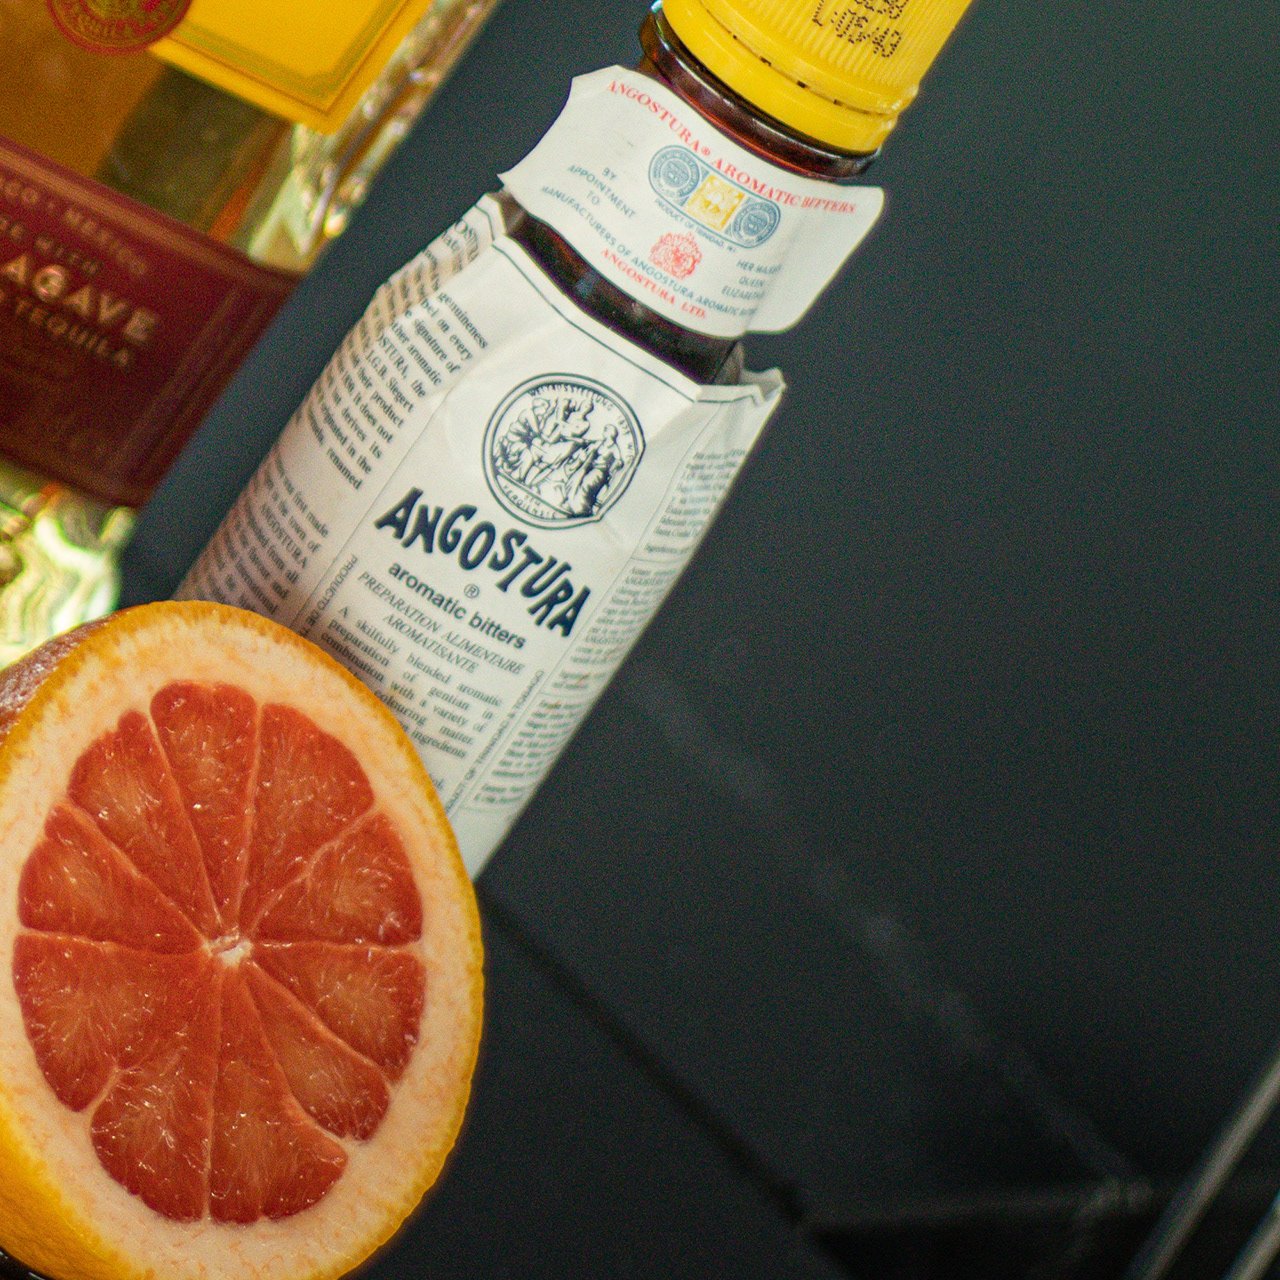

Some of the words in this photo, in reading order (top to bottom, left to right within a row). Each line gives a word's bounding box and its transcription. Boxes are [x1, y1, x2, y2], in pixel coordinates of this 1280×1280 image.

[568, 164, 637, 220] APPOINTMENT
[587, 191, 601, 206] TO
[602, 167, 618, 181] BY
[710, 157, 802, 208] AROMATIC
[801, 196, 857, 214] BITTERS
[541, 186, 616, 248] MANUFACTURERS
[617, 243, 632, 258] OF
[631, 256, 694, 300] ANGOSTURA
[736, 259, 756, 272] HER
[0, 255, 157, 345] AGAVE
[600, 247, 676, 306] ANGOSTURA
[413, 318, 448, 362] signature
[445, 361, 461, 374] of
[437, 318, 450, 334] on
[448, 334, 473, 362] every
[438, 292, 489, 350] genuineness
[407, 343, 442, 387] aromatic
[410, 378, 427, 398] the
[370, 390, 405, 429] product
[386, 376, 415, 413] Siegert
[341, 406, 367, 442] derives
[369, 441, 383, 459] its
[359, 402, 379, 428] does
[376, 424, 394, 444] not
[326, 447, 363, 491] renamed
[346, 442, 357, 458] in
[356, 454, 372, 475] the
[306, 511, 329, 538] made
[307, 540, 322, 554] of
[285, 569, 300, 585] all
[317, 553, 358, 612] PRODUCTO
[373, 486, 591, 638] ANGOSTURA
[357, 571, 441, 634] PREPARATION
[441, 630, 525, 674] ALIMENTAIRE
[388, 562, 468, 620] aromatic
[468, 611, 527, 650] bitters
[328, 619, 390, 667] preparation
[402, 671, 419, 683] of
[427, 686, 471, 711] gentian
[338, 605, 349, 619] A
[354, 620, 400, 655] skilfully
[406, 652, 452, 684] blended
[457, 683, 503, 708] aromatic
[382, 613, 480, 674] AROMATISANTE
[321, 632, 385, 683] combination
[390, 680, 415, 701] with
[433, 705, 468, 727] variety
[473, 722, 488, 733] of
[411, 729, 468, 759] ingredients
